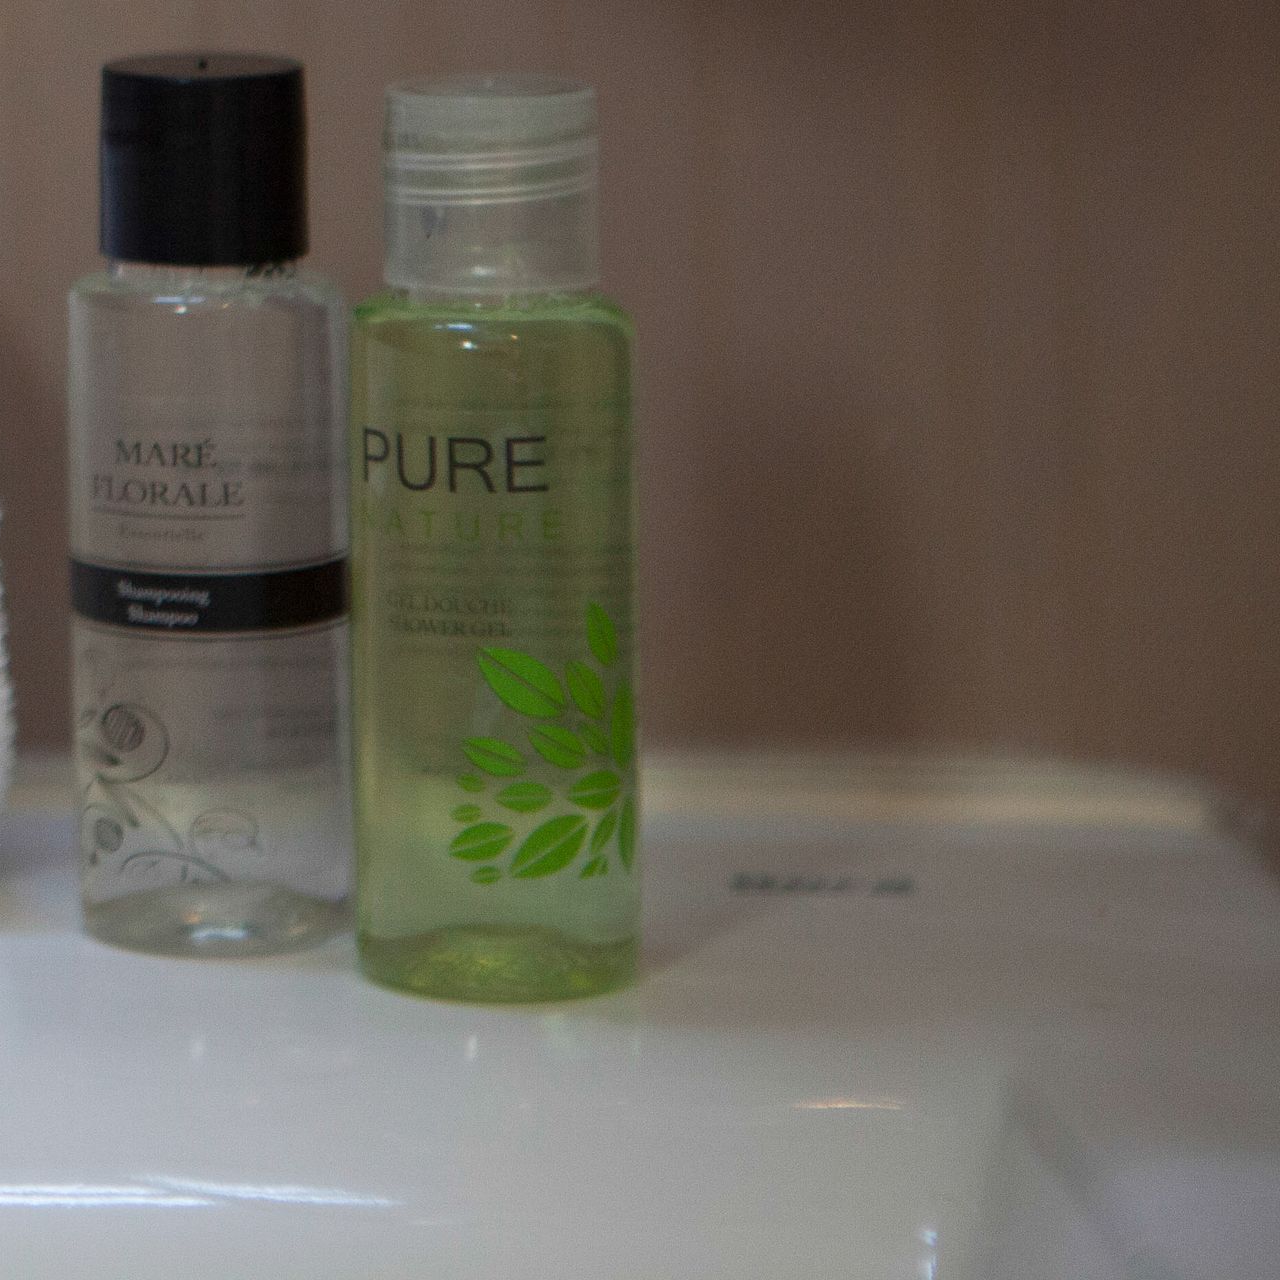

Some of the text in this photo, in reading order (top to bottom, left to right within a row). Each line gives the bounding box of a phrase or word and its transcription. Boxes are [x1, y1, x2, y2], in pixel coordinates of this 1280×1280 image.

[114, 438, 217, 470] MARÉ
[362, 427, 549, 493] PURE
[92, 474, 245, 507] FLORALE
